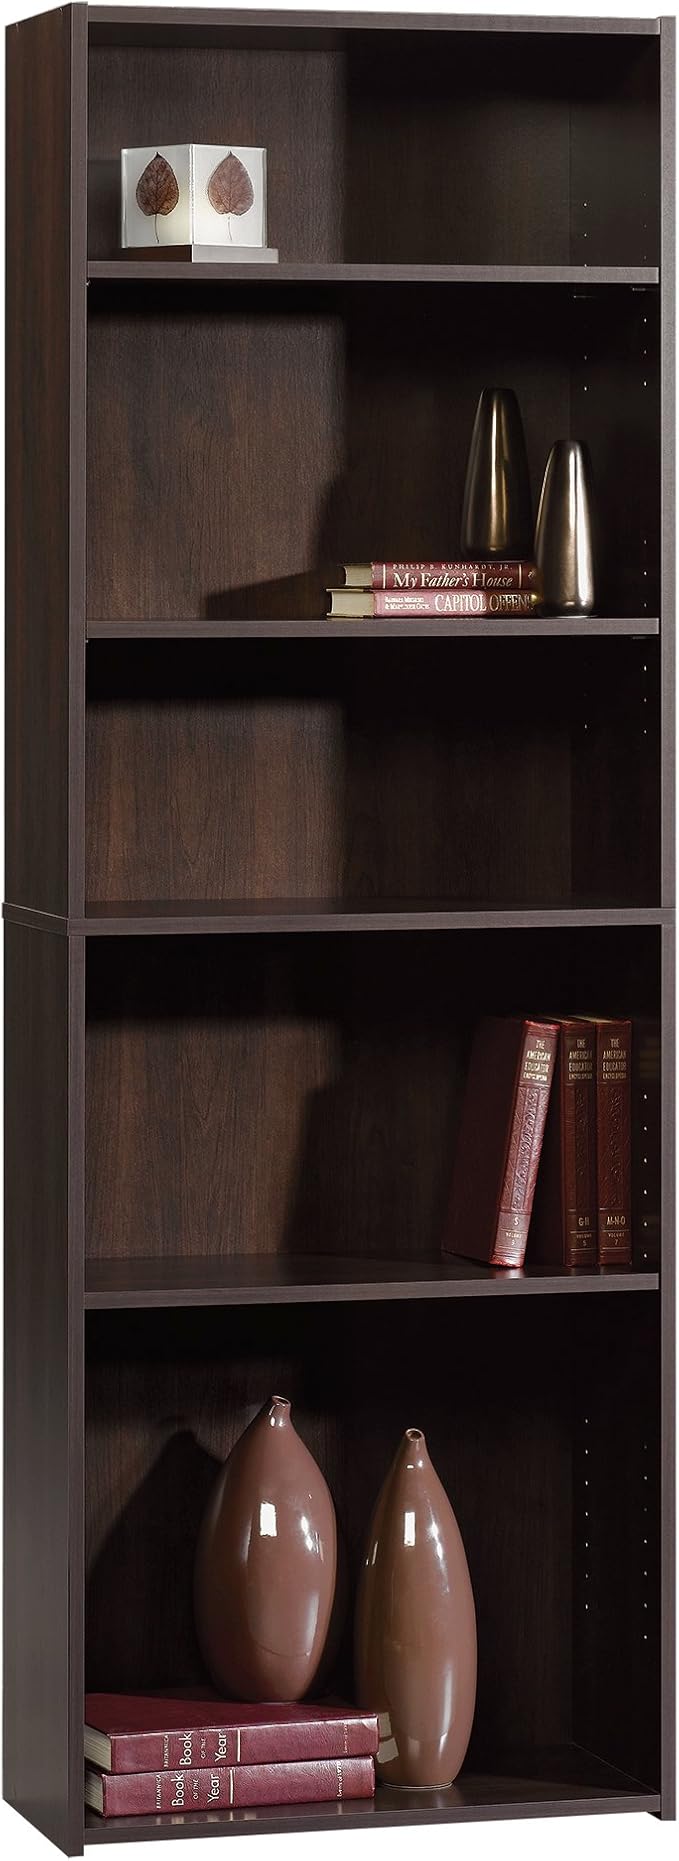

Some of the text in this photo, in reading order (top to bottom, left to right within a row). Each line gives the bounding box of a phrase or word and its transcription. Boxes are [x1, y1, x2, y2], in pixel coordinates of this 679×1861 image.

[393, 572, 514, 590] My Father's House
[434, 594, 487, 612] CAPITOL
[535, 1039, 546, 1050] THE
[576, 1039, 587, 1049] THE
[610, 1038, 620, 1049] THE
[526, 1050, 552, 1061] AMERICAN
[568, 1050, 593, 1060] AMERICAN
[602, 1050, 627, 1060] AMERICAN
[524, 1061, 550, 1074] EDUCATOR
[568, 1062, 593, 1072] EDUCATOR
[602, 1061, 627, 1072] EDUCATOR
[513, 1216, 520, 1226] S
[178, 1731, 193, 1766] Book
[214, 1733, 227, 1762] Year
[170, 1772, 185, 1806] Book
[207, 1773, 220, 1803] Year
